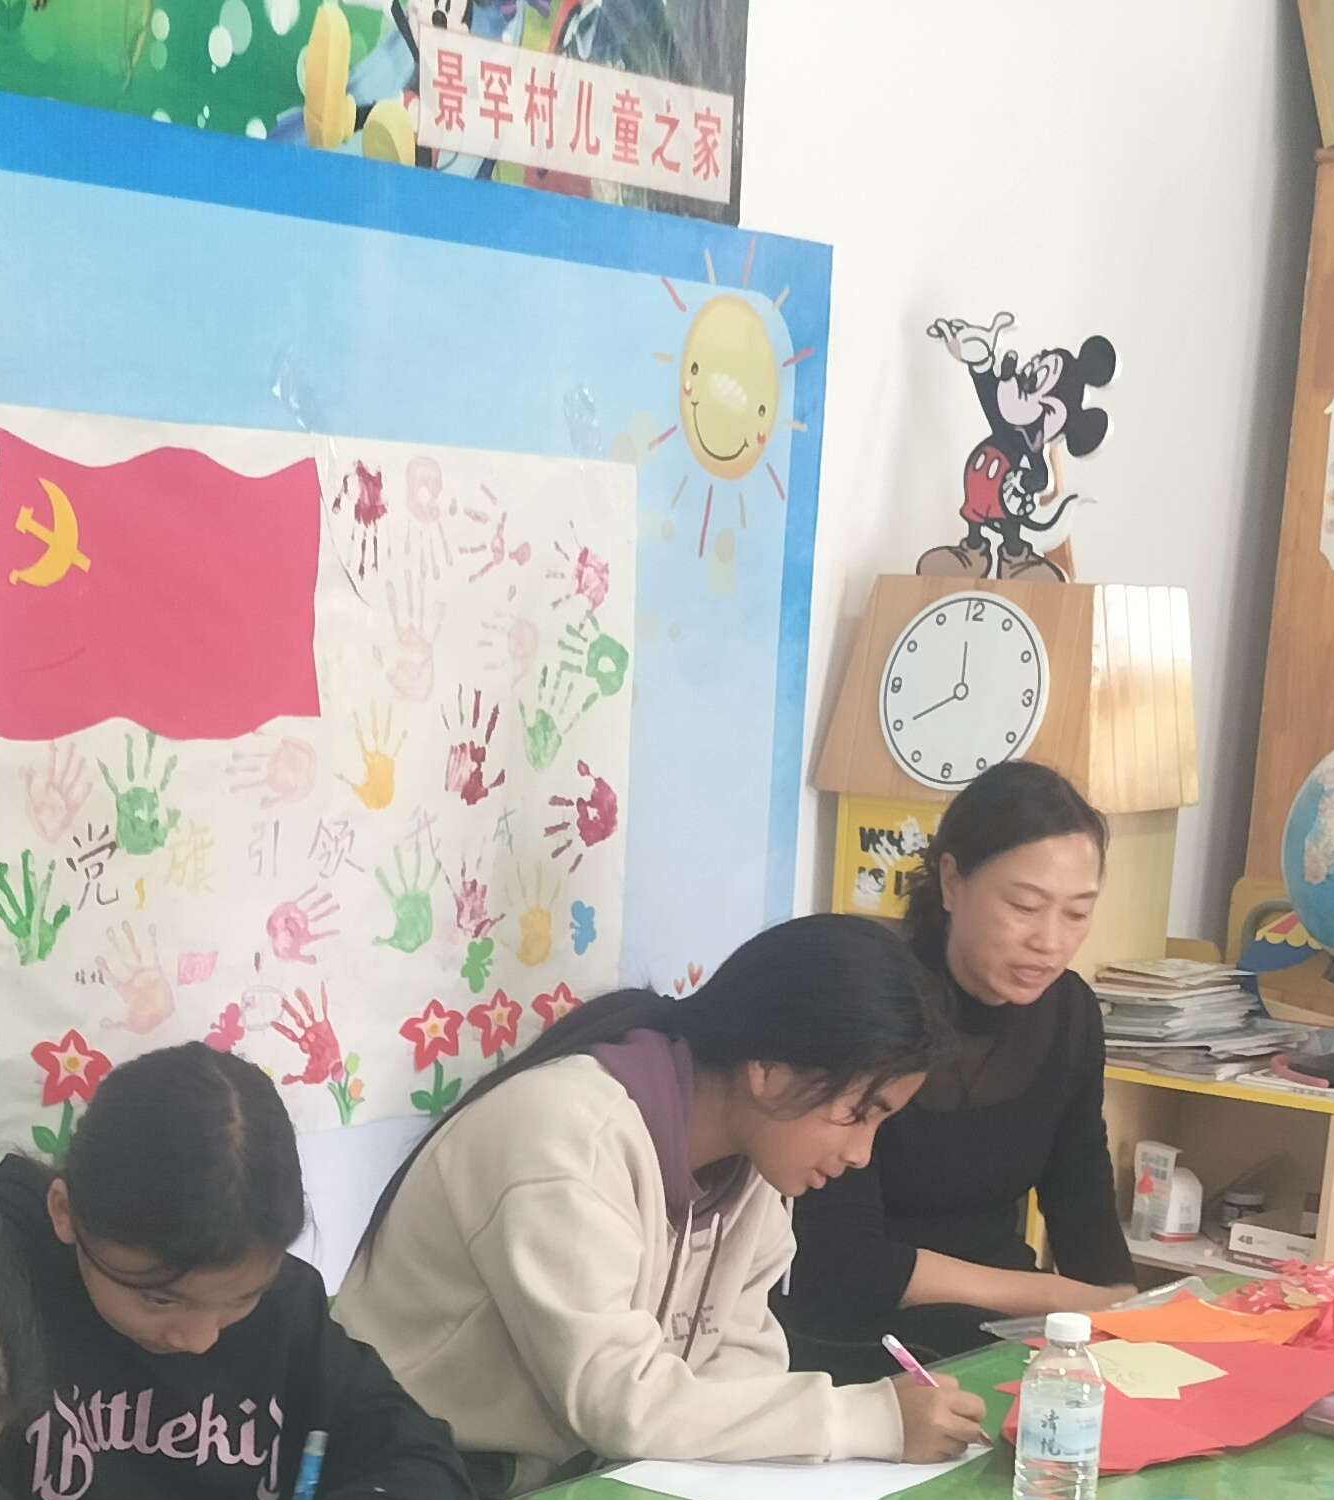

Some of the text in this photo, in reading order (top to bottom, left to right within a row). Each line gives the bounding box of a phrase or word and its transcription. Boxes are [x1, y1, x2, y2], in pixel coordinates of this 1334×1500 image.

[432, 48, 722, 181] 景罕村儿童之家
[890, 676, 902, 693] 9
[1021, 688, 1034, 707] 3
[940, 762, 953, 779] 6
